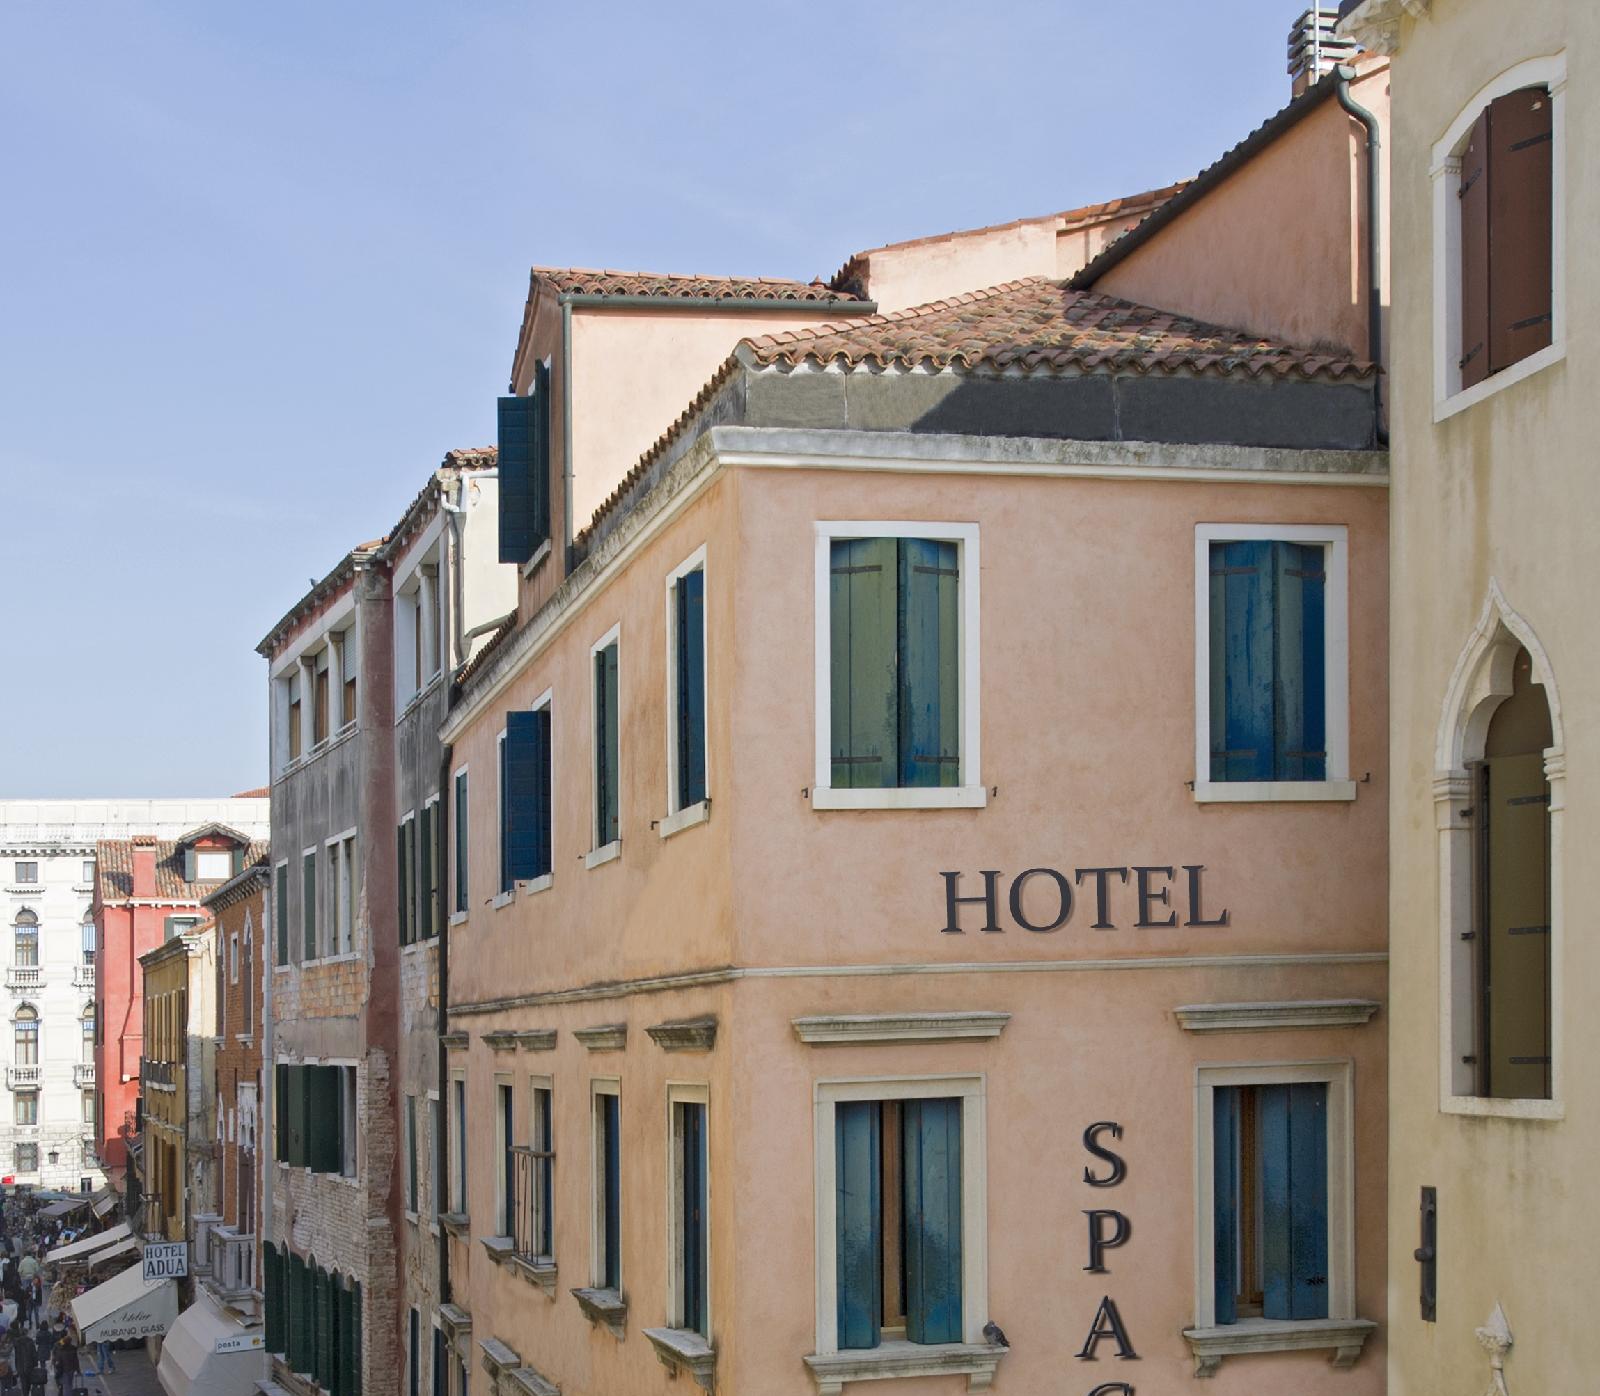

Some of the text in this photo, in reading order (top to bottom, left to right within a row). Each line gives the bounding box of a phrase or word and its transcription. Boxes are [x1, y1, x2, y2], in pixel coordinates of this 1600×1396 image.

[939, 865, 1228, 933] HOTEL
[145, 1245, 185, 1259] HOTEL
[146, 1258, 185, 1277] ADUA
[100, 1323, 165, 1338] MURANO GLASS
